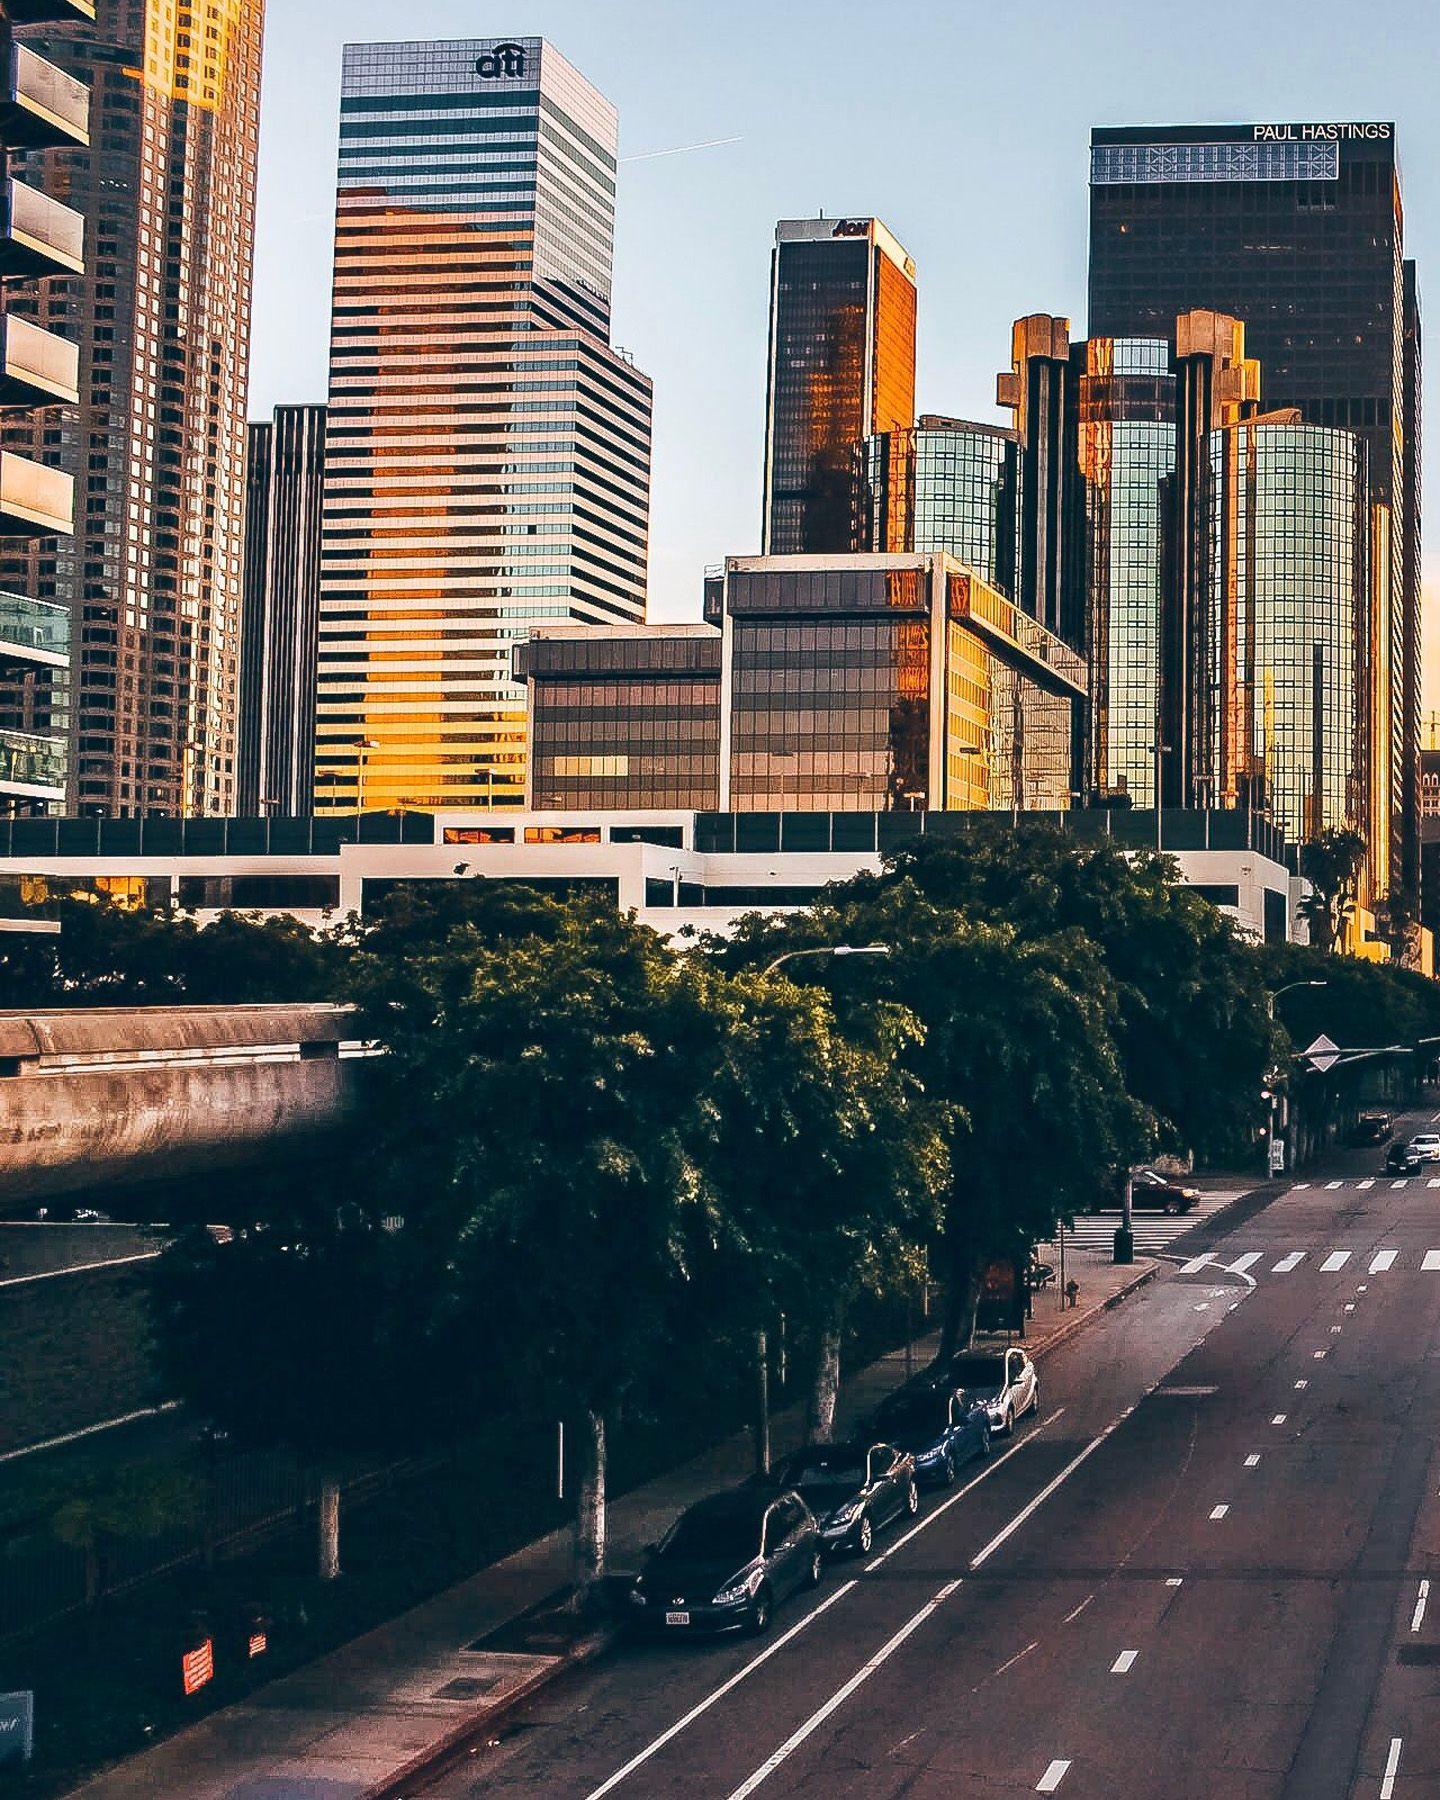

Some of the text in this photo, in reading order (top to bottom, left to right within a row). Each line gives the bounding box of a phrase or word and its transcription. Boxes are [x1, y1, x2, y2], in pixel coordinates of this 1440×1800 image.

[476, 43, 527, 78] citi
[1253, 123, 1391, 140] PAUL HASTINGS
